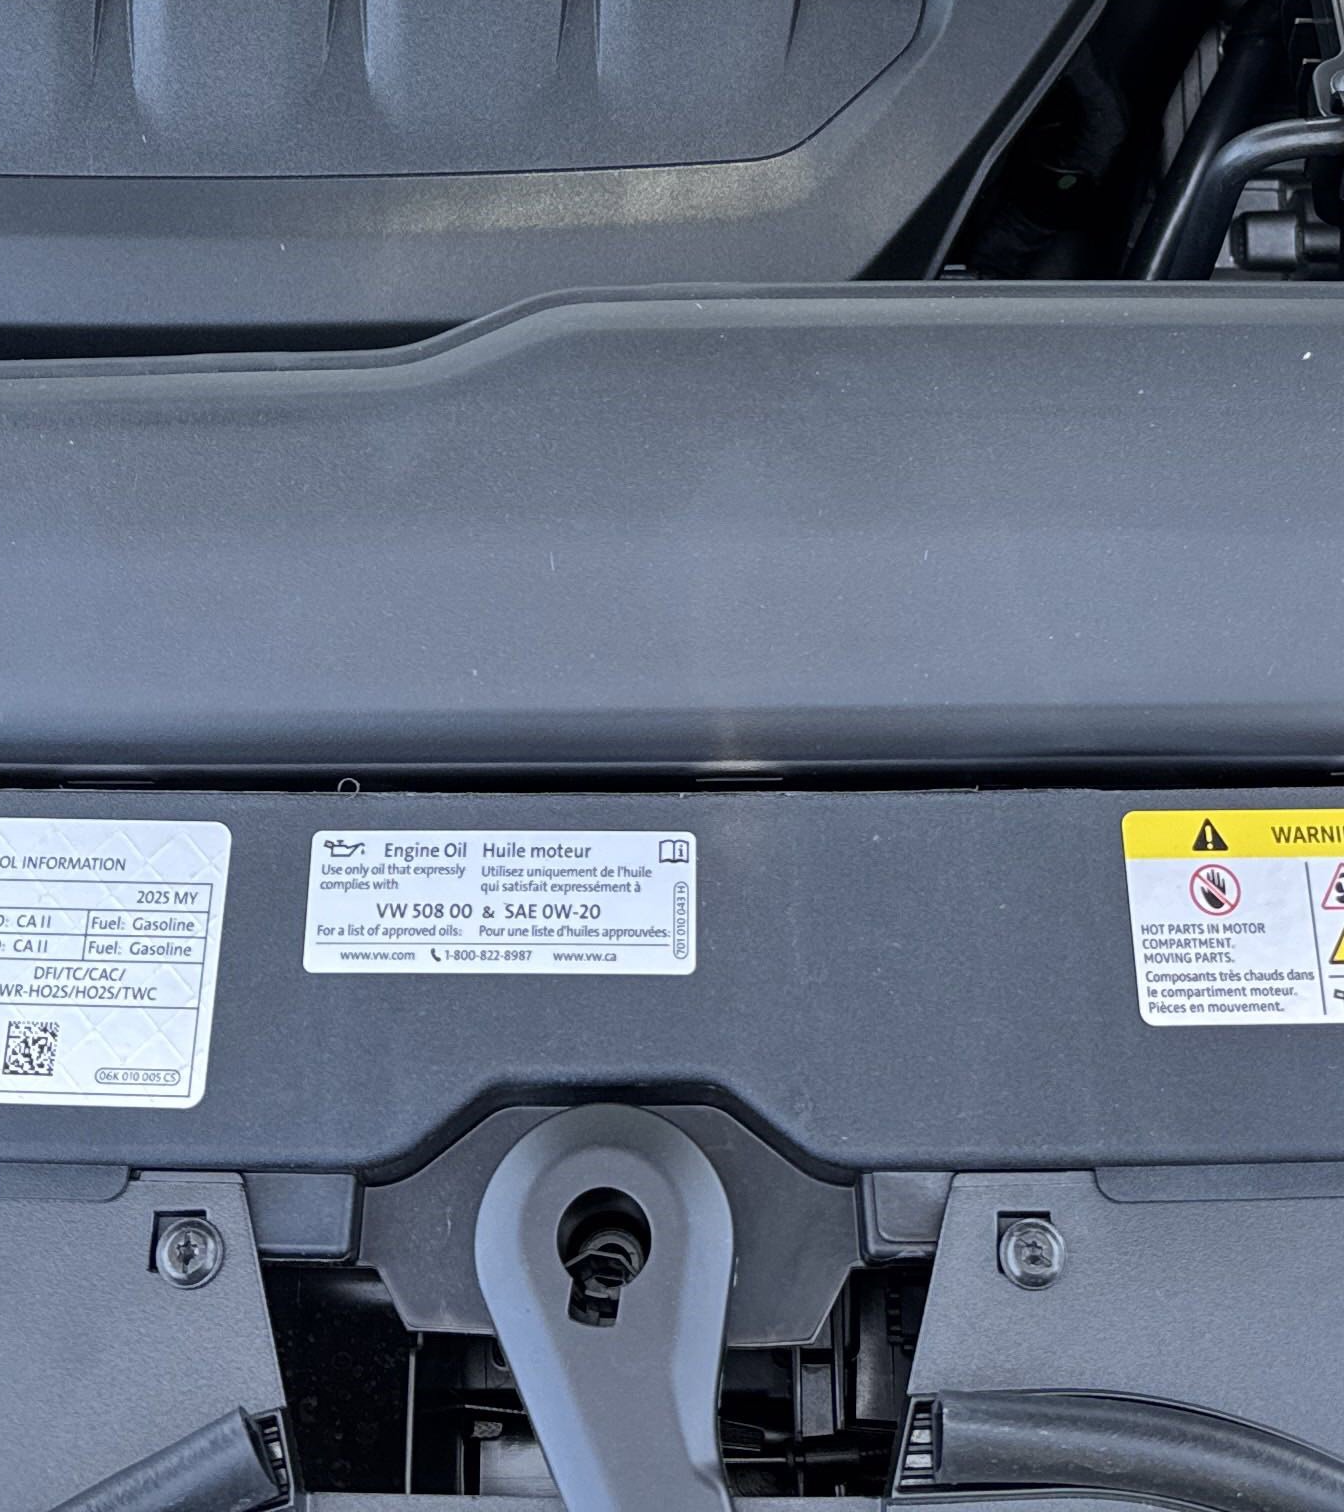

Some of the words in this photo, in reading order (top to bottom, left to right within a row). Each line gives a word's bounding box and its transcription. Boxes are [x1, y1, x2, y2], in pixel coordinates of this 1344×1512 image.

[383, 841, 440, 862] Engine
[443, 841, 467, 858] Oil
[482, 841, 526, 858] Huile
[530, 843, 591, 858] moteur
[21, 855, 126, 871] INFORMATION
[320, 863, 343, 875] Use
[343, 862, 369, 879] only
[369, 862, 385, 880] oil
[386, 862, 412, 877] that
[412, 862, 466, 879] expressly
[480, 864, 524, 877] Utilisez
[525, 866, 598, 880] uniquement
[599, 865, 615, 878] de
[319, 877, 370, 893] complies
[372, 877, 399, 890] with
[479, 879, 499, 895] qui
[501, 879, 548, 892] satisfait
[549, 880, 631, 895] expressément
[135, 889, 170, 904] 2025
[173, 890, 199, 905] MY
[375, 902, 408, 919] VW
[411, 902, 444, 919] 508
[448, 902, 473, 919] 00
[503, 902, 537, 919] SAE
[541, 903, 601, 920] 0W-20
[15, 913, 37, 928] CA
[90, 915, 125, 930] Fuel:
[131, 916, 195, 932] Gasoline
[1140, 923, 1165, 935] HOT
[1167, 922, 1205, 935] PARTS
[1206, 922, 1220, 934] IN
[1221, 921, 1266, 935] MOTOR
[316, 923, 336, 936] For
[336, 926, 345, 936] a
[347, 923, 365, 936] list
[366, 923, 381, 936] of
[381, 924, 436, 939] approved
[437, 923, 462, 936] oils:
[478, 924, 506, 937] Pour
[506, 927, 529, 937] une
[530, 924, 555, 937] liste
[601, 925, 670, 941] approuvées:
[12, 938, 33, 953] CA
[87, 939, 121, 955] Fuel:
[128, 940, 192, 957] Gasoline
[1141, 936, 1234, 949] COMPARTMENT.
[339, 951, 415, 960] www.vw.com
[444, 949, 532, 961] 1-800-822-8987
[552, 952, 617, 962] www.vw.ca
[1143, 951, 1192, 964] MOVING
[1194, 951, 1235, 963] PARTS.
